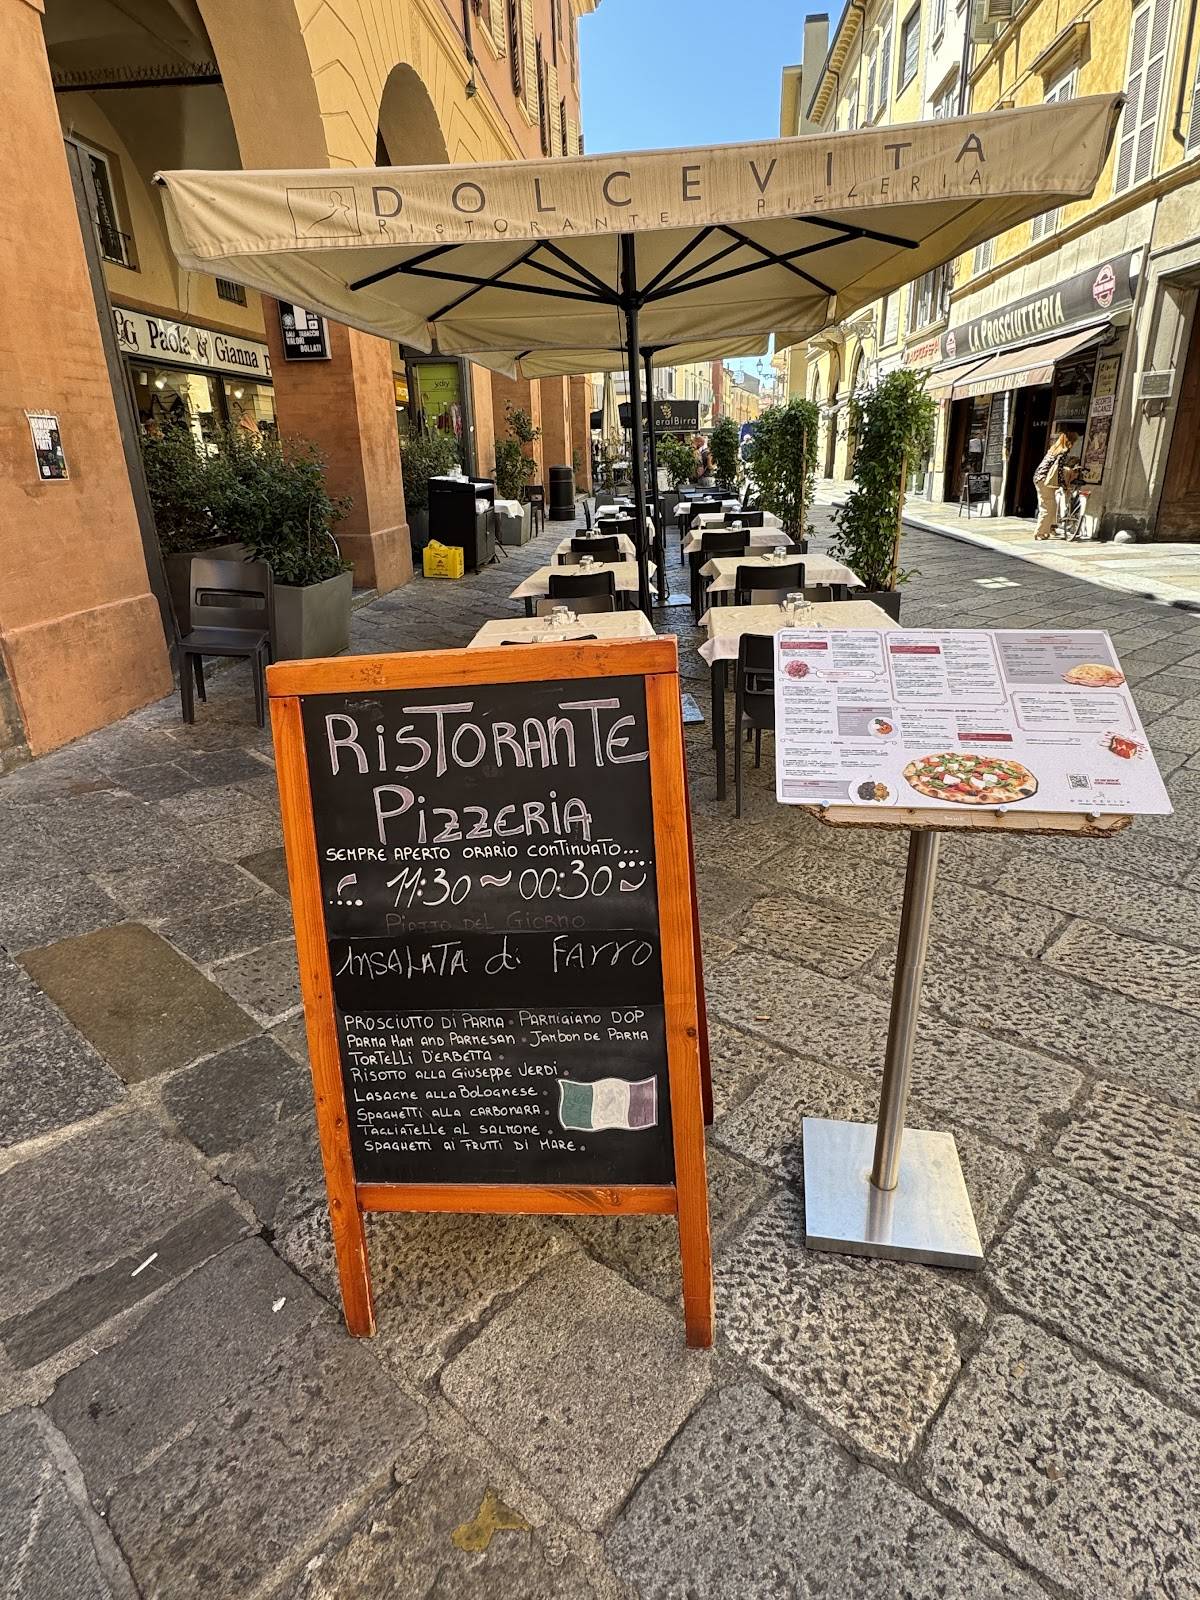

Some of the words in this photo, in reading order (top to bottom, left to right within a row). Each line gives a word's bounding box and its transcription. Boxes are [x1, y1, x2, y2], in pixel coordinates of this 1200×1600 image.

[378, 211, 669, 234] RISTORANTE
[968, 325, 982, 352] LA
[981, 292, 1064, 348] PROSCIUTTERIA
[146, 320, 190, 356] Paola
[197, 331, 210, 365] &
[215, 336, 259, 368] Gianna
[300, 344, 322, 353] BOLLATI
[656, 416, 697, 426] eralBirra
[326, 847, 387, 861] SEMPRE
[394, 847, 450, 861] APERTO
[387, 866, 472, 908] 11:30
[519, 859, 613, 900] 00:30
[611, 1009, 645, 1024] DOP
